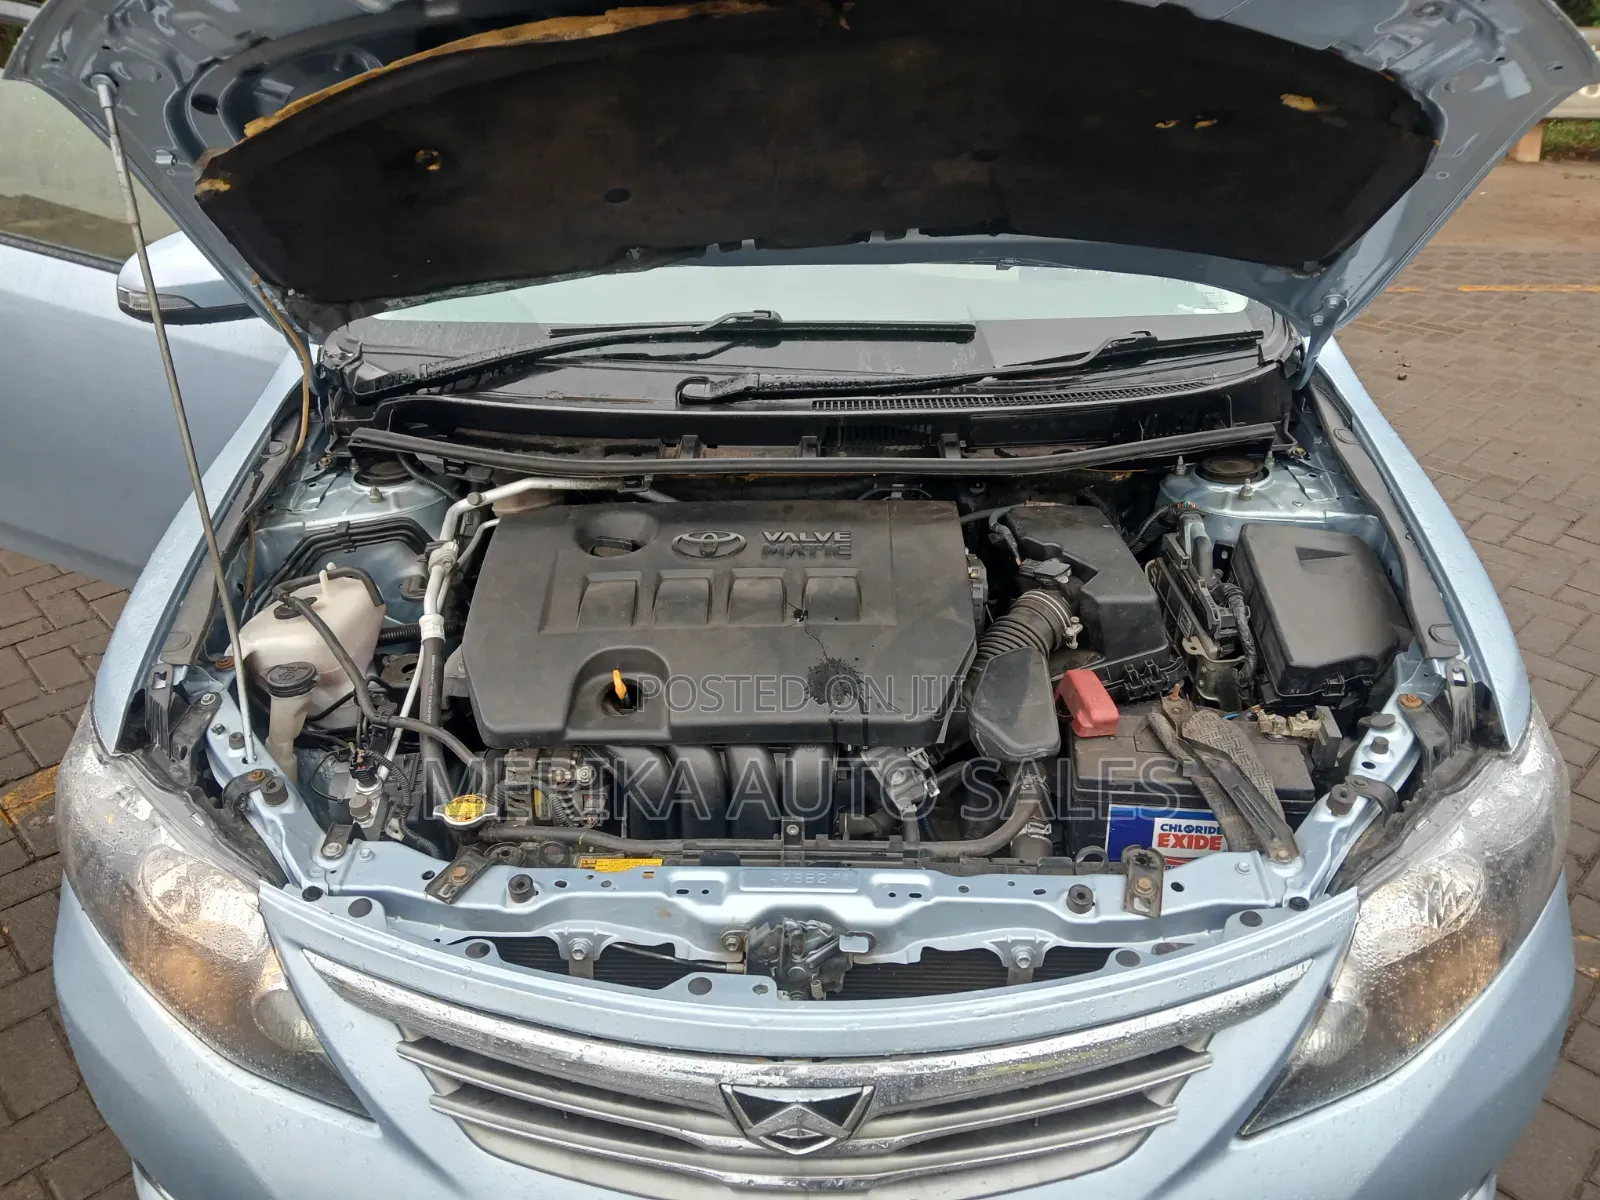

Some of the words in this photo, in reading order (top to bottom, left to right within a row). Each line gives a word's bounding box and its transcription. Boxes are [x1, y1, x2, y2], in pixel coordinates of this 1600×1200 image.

[761, 531, 852, 543] VALVE
[761, 544, 852, 559] MATIC
[1160, 823, 1223, 835] CHLORIDE
[1157, 833, 1223, 851] EXIDE
